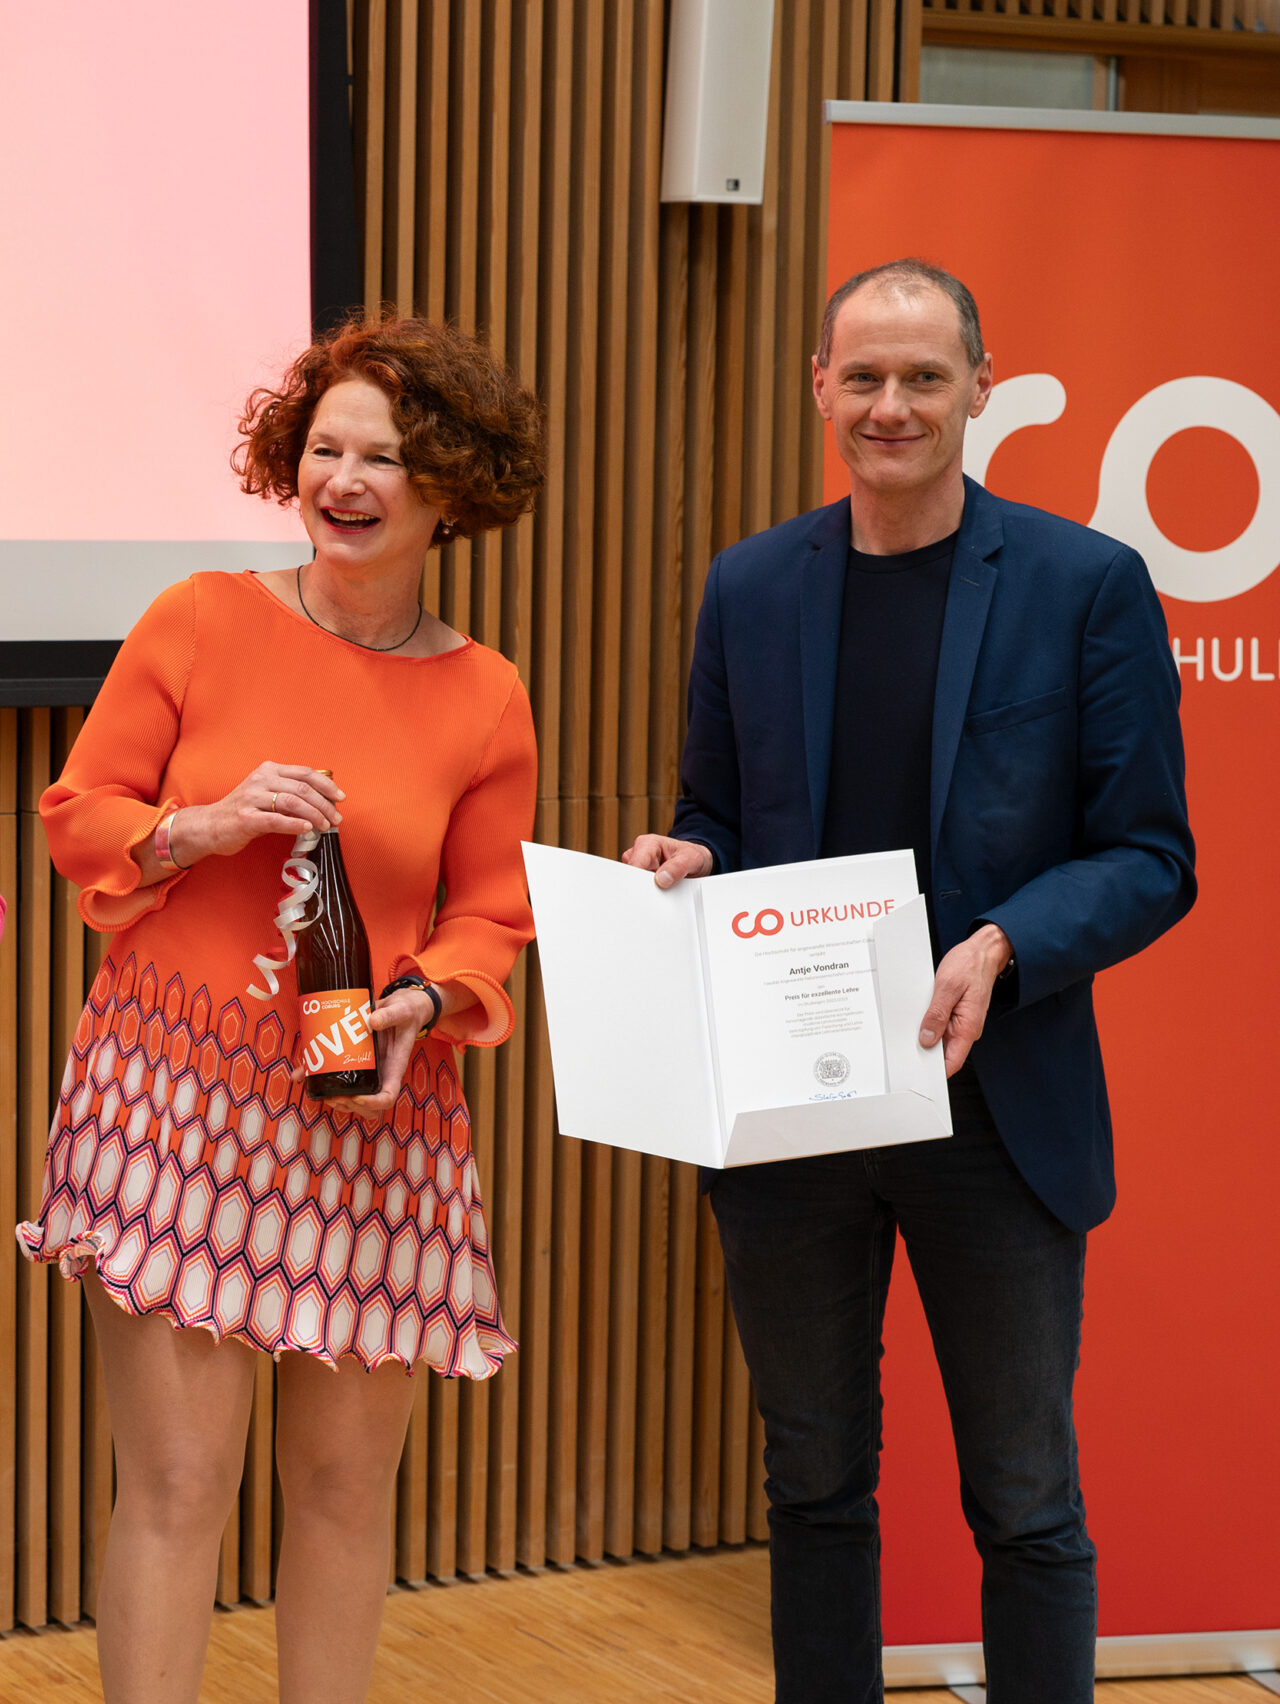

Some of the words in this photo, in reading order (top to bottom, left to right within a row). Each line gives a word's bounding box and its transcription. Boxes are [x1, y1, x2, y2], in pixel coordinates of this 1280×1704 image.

[1172, 636, 1280, 682] HUL
[789, 966, 812, 976] Antje
[813, 962, 850, 973] Vondran
[784, 993, 800, 1001] Preis
[811, 989, 842, 998] exzellente
